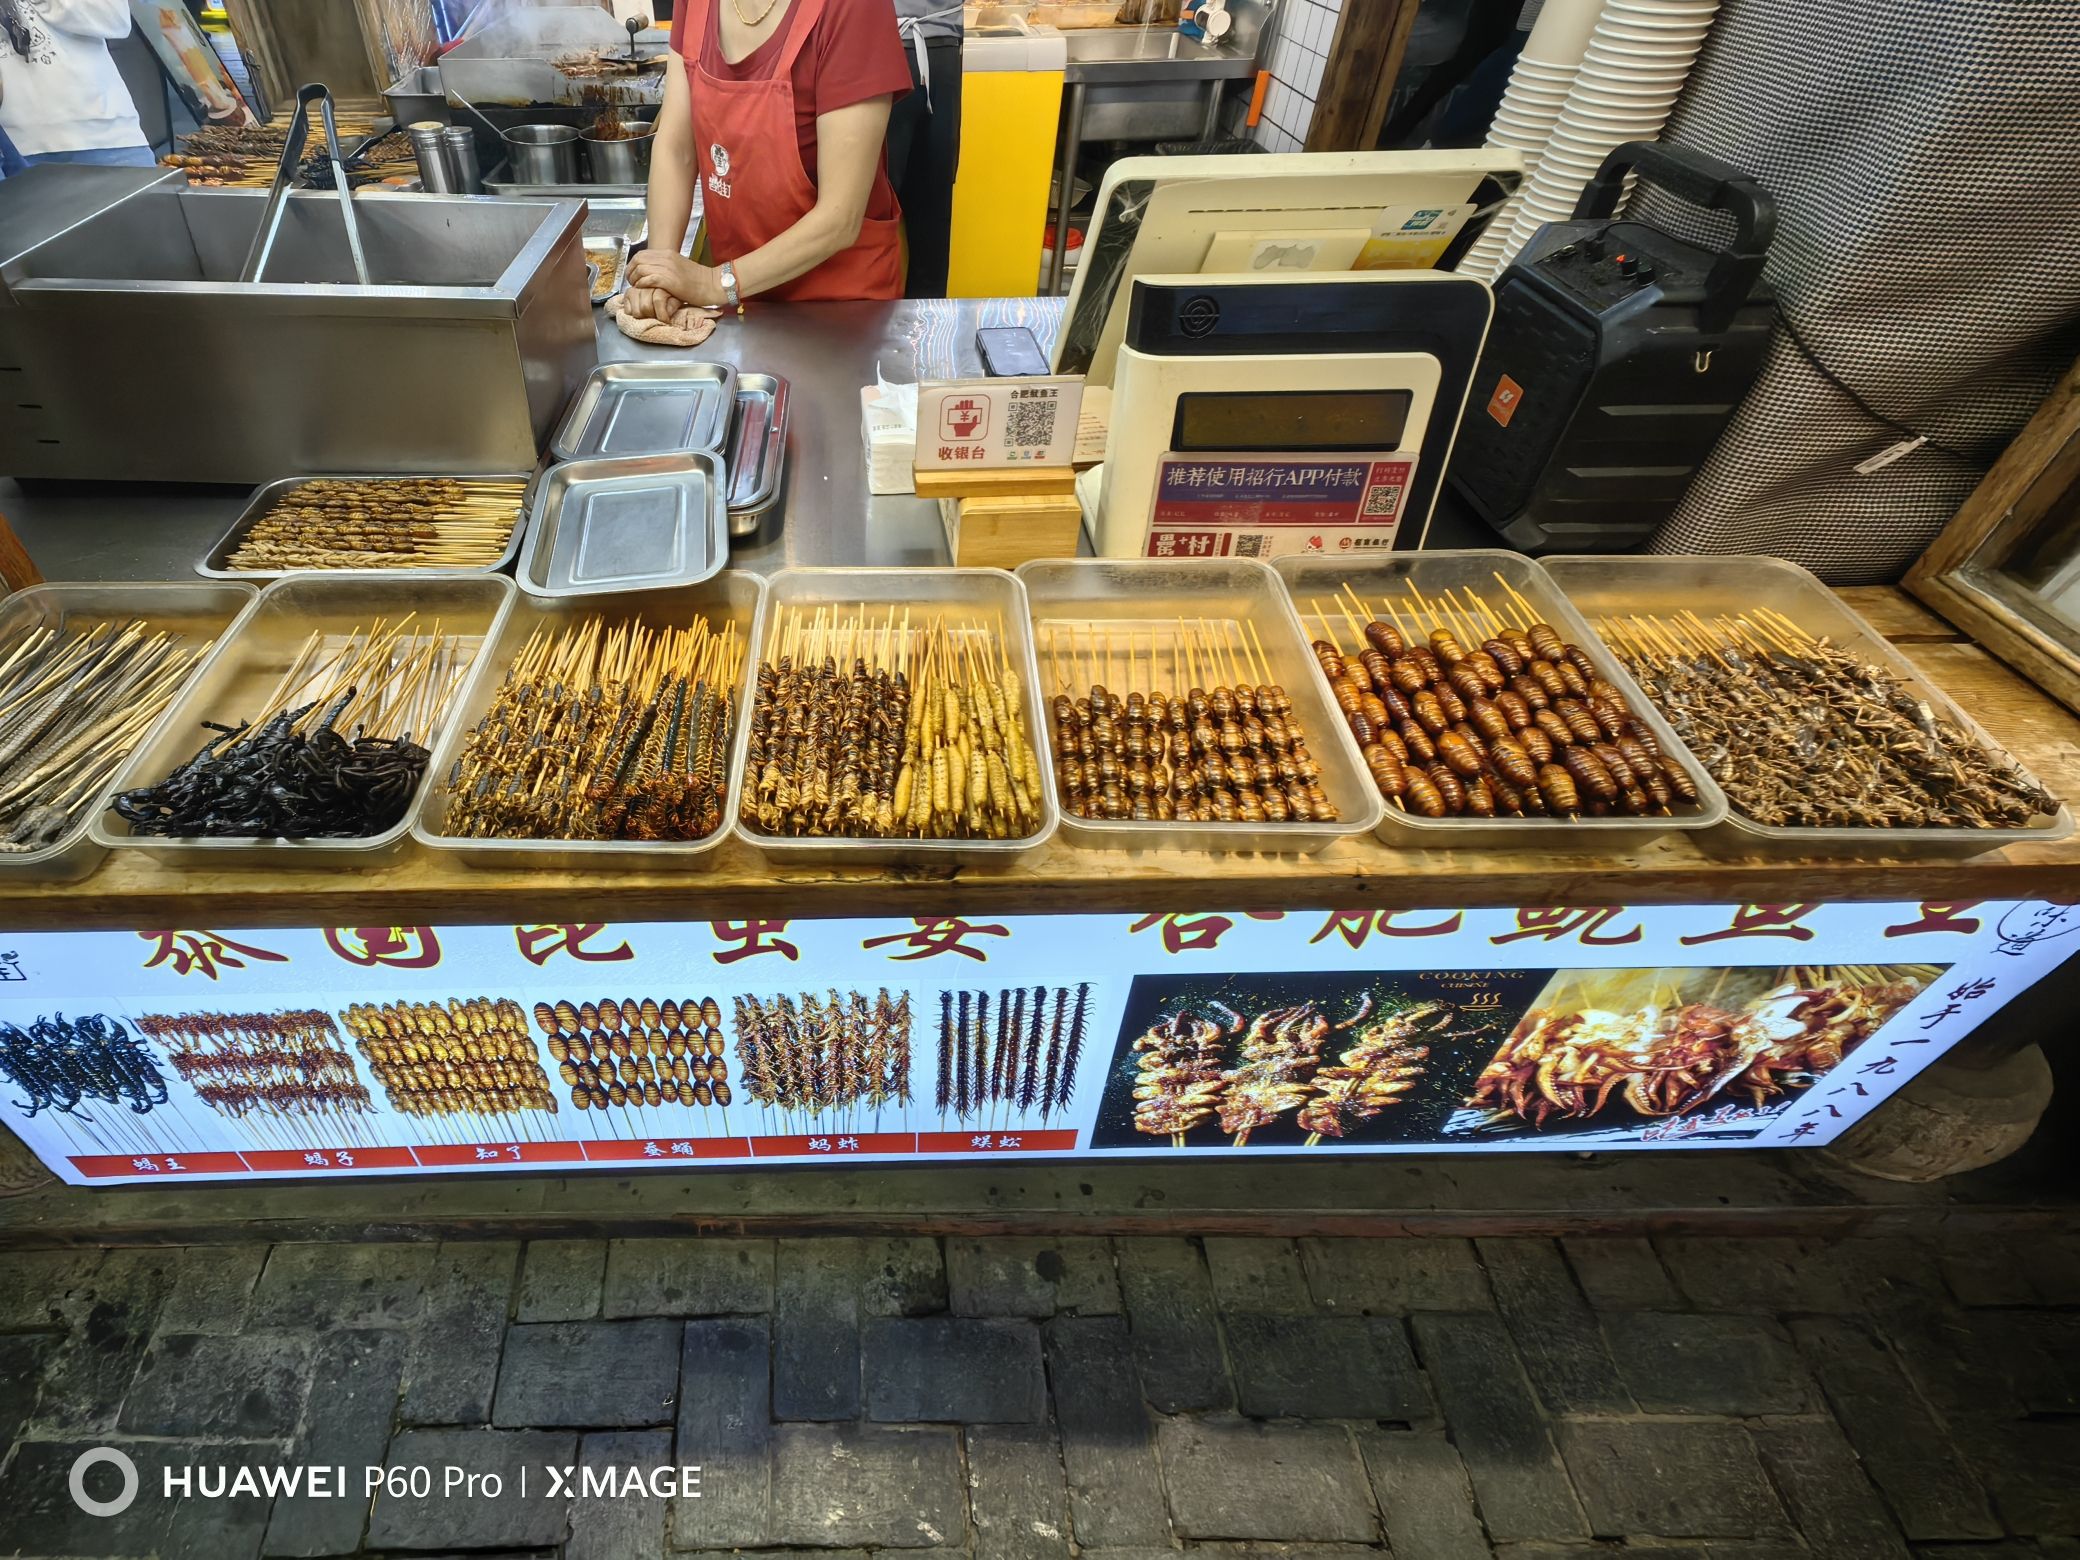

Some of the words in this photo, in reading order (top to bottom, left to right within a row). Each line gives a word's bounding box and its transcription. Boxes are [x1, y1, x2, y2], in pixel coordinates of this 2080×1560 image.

[1011, 389, 1058, 399] 合肥鱿鱼王
[938, 446, 985, 460] 收银台
[1167, 466, 1362, 487] 推荐使用招行APP付款
[643, 1142, 694, 1156] 蚕蛹
[807, 1137, 859, 1152] 蚂蚱
[971, 1135, 1022, 1149] 蜈蚣
[304, 1151, 354, 1167] 蝎子
[475, 1146, 522, 1160] 知了
[132, 1157, 187, 1172] 蝎王
